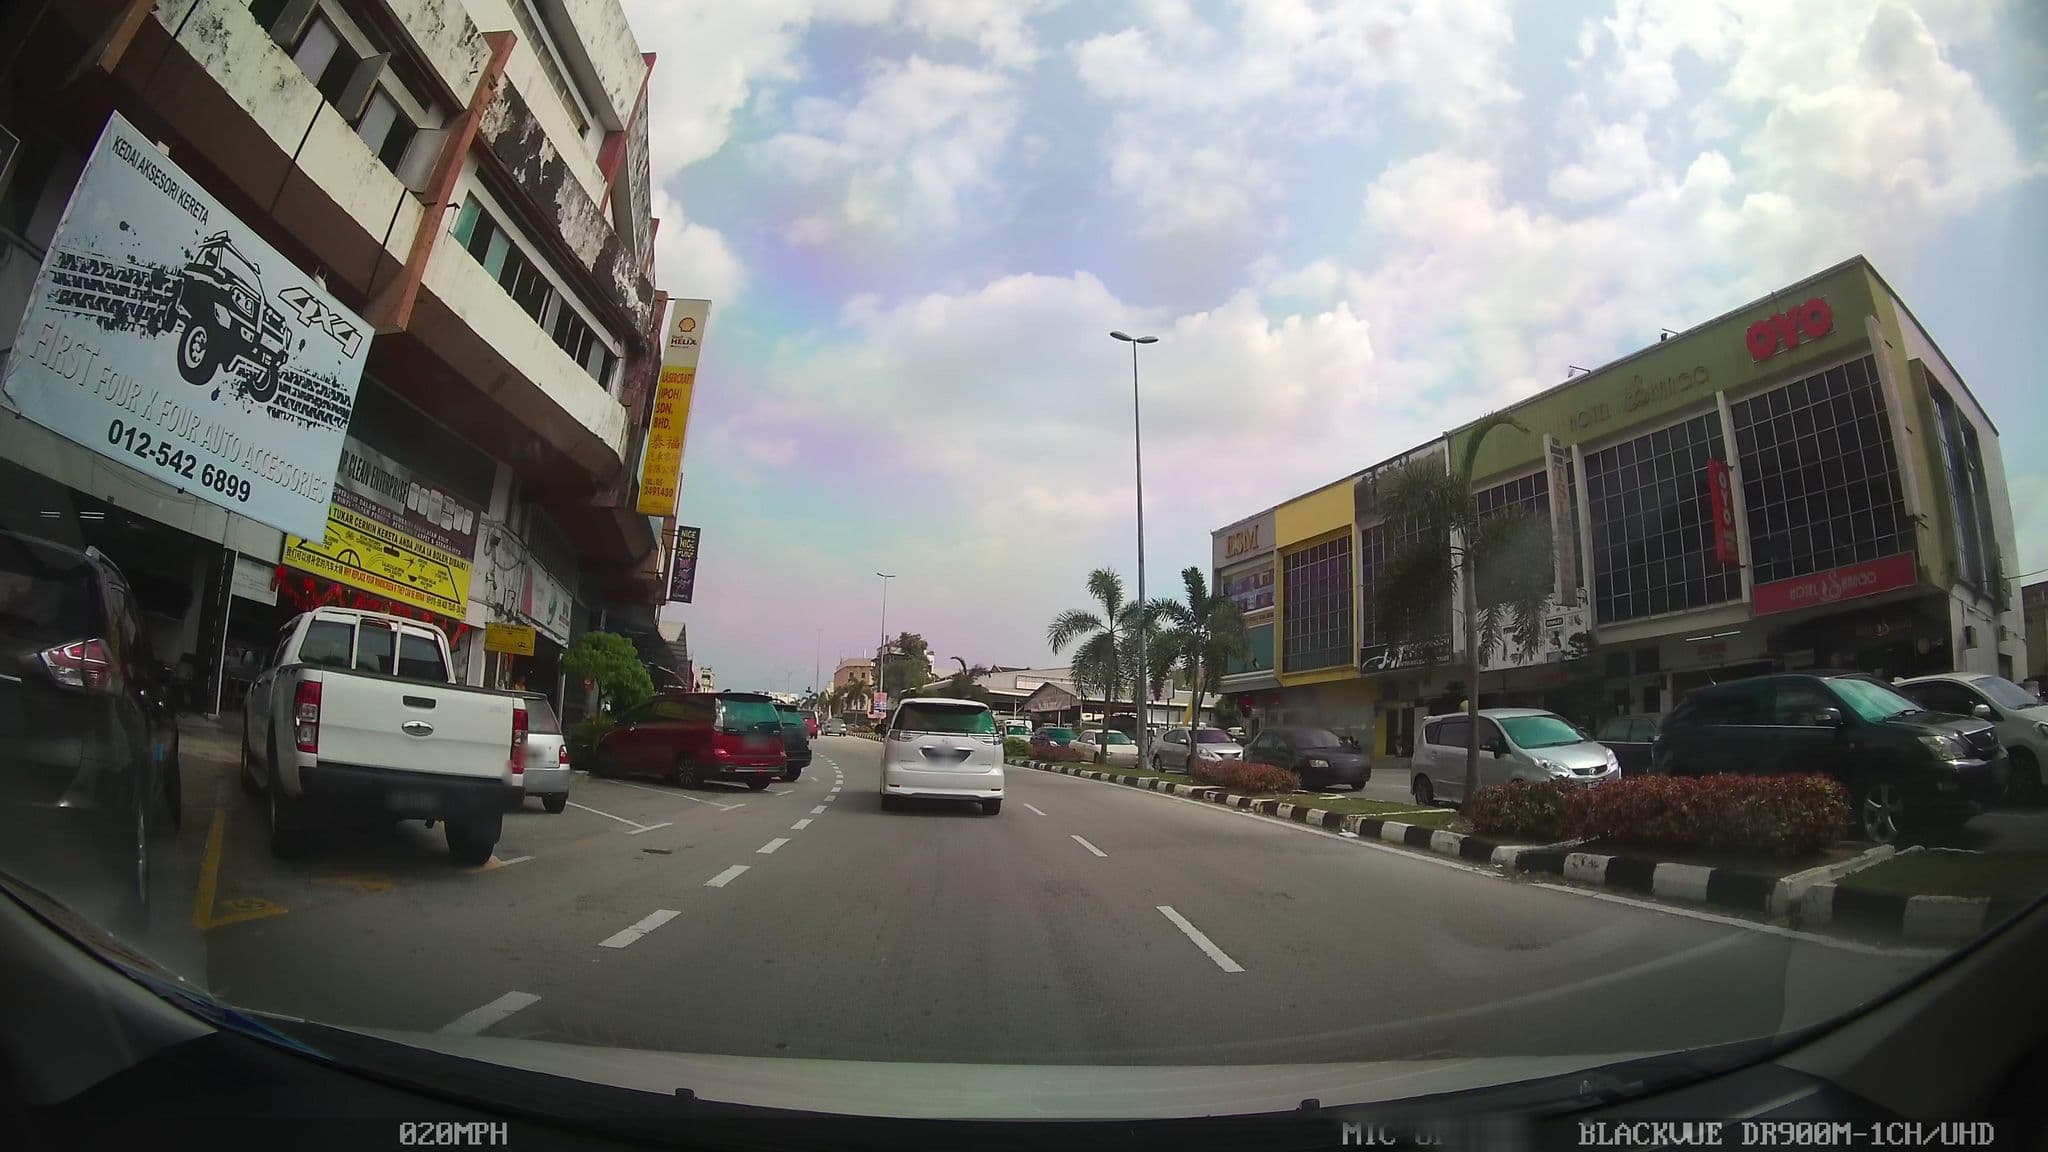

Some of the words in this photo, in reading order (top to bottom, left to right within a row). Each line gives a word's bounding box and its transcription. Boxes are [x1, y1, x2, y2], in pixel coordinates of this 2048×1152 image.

[112, 135, 141, 169] KEDAI
[137, 156, 181, 201] AKSESORI
[177, 187, 209, 226] KERETA
[671, 338, 697, 346] HELIX
[1745, 296, 1834, 362] OYO
[29, 320, 101, 387] FIRST
[94, 366, 146, 414] FOUR
[140, 389, 160, 422] X
[155, 400, 202, 444] FOUR
[199, 420, 242, 464] AUTO
[242, 442, 328, 505] ACCESSORIES
[107, 418, 199, 479] 012-542
[201, 463, 252, 504] 6899
[348, 454, 371, 487] CLEAN
[370, 465, 409, 507] ENTERPRISE
[333, 507, 354, 524] TUKAR
[354, 517, 377, 534] CERMIN
[377, 527, 398, 544] KERETA
[1718, 471, 1732, 526] OYO
